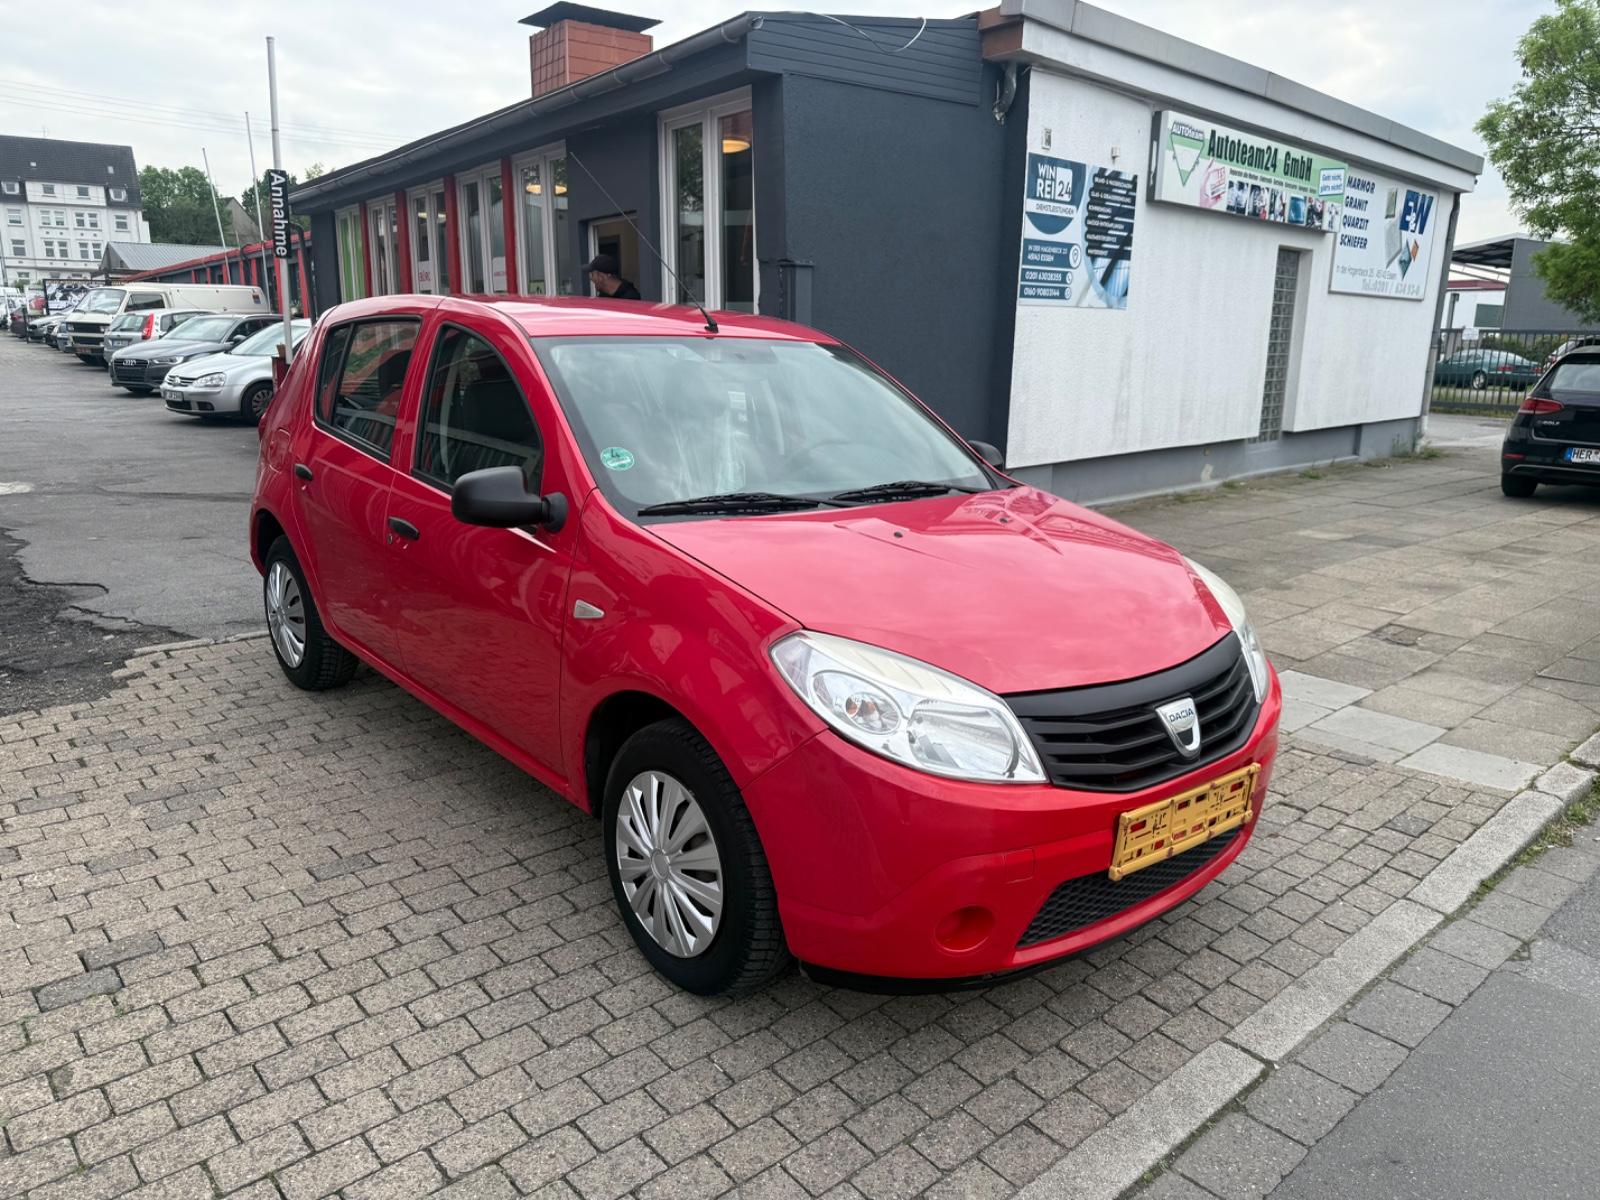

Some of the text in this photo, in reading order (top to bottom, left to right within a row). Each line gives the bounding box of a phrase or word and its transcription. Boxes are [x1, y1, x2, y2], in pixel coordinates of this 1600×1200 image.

[1207, 129, 1278, 173] Autoteam24
[1283, 151, 1313, 182] GmbH
[1038, 163, 1056, 179] WIN
[1036, 179, 1071, 200] REI 24
[1347, 176, 1375, 194] MARMOR
[1036, 204, 1075, 215] DIENSTLEISTUNGEN
[1345, 195, 1368, 211] GRANIT
[270, 172, 288, 256] Annahme
[1342, 215, 1369, 231] QUARZIT
[1340, 234, 1368, 249] SCHIEFER
[1572, 449, 1592, 460] HER
[1169, 708, 1194, 722] DACIA
